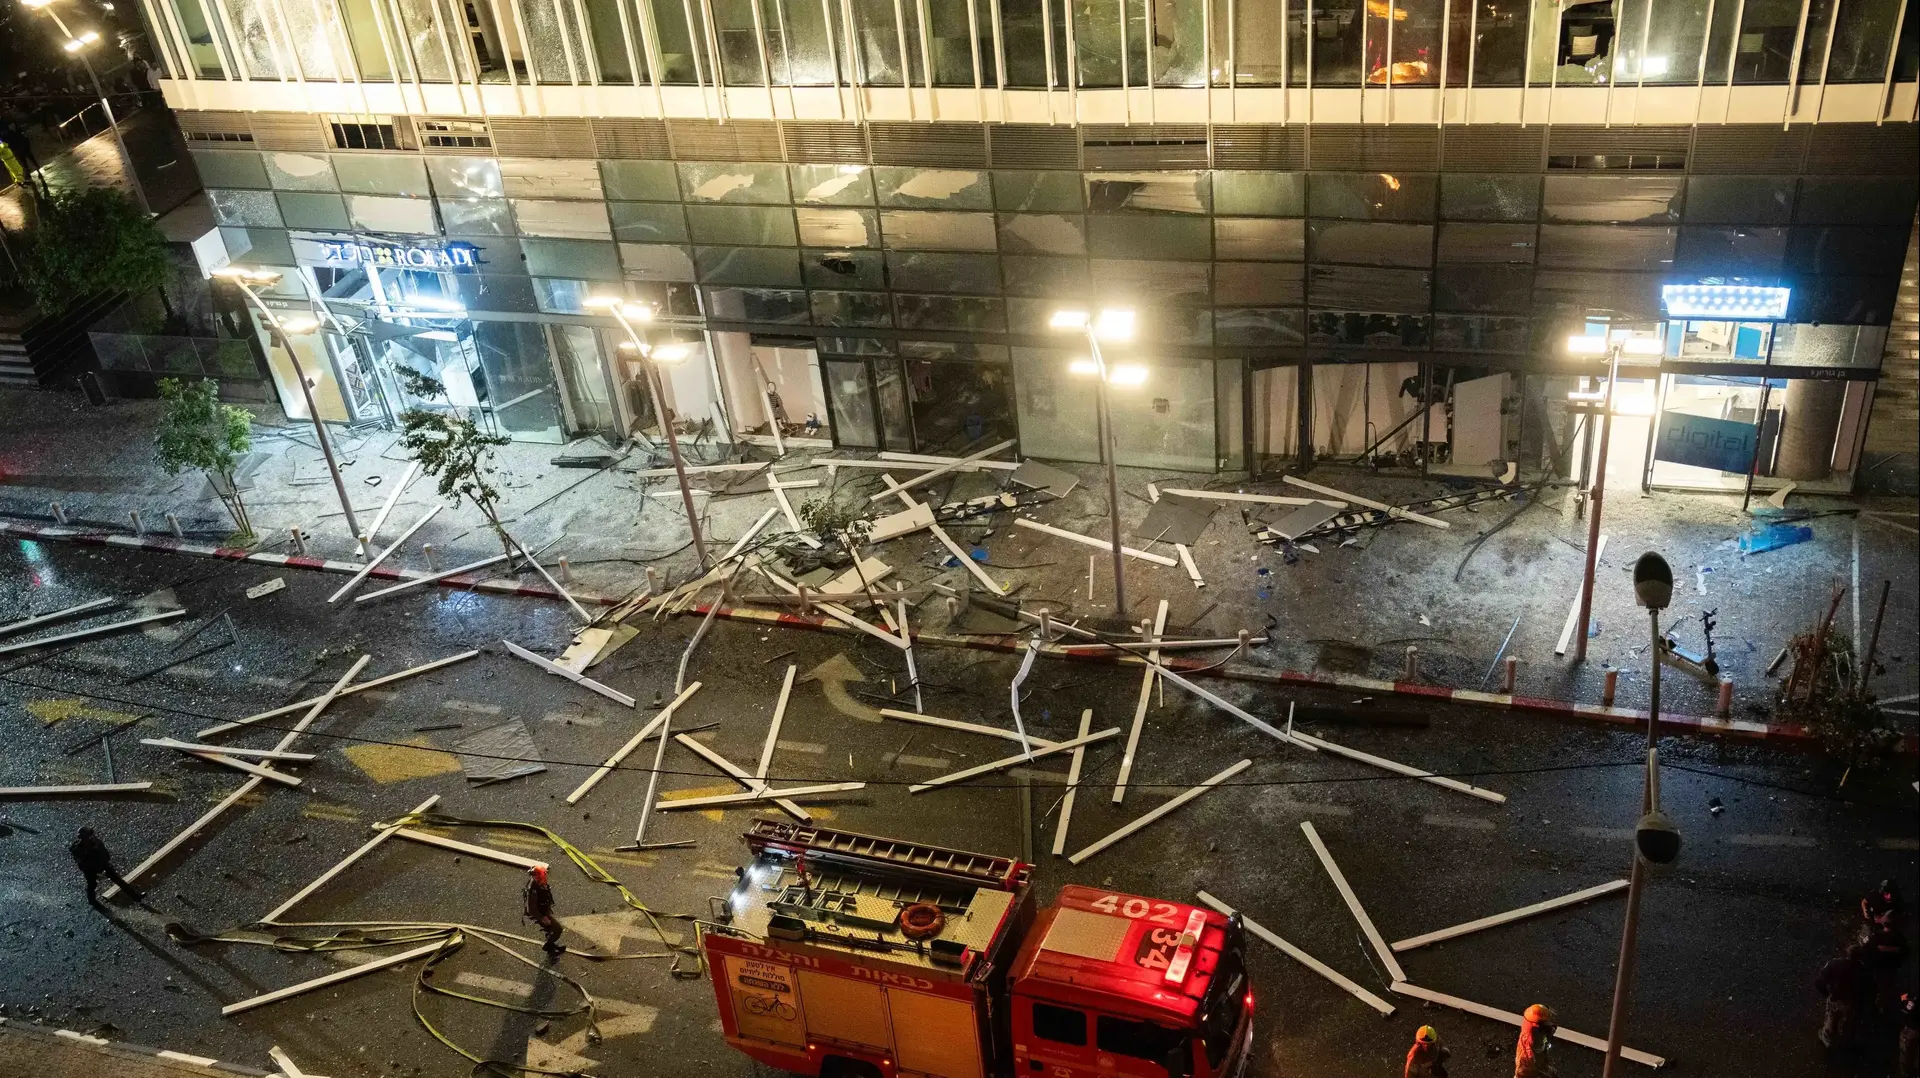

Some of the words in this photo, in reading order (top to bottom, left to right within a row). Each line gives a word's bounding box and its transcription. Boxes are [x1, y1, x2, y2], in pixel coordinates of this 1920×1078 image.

[1667, 425, 1748, 451] digital
[1091, 895, 1179, 925] 402
[741, 942, 820, 969] והצלה
[1140, 928, 1183, 969] 3-4
[851, 964, 934, 990] כבאות
